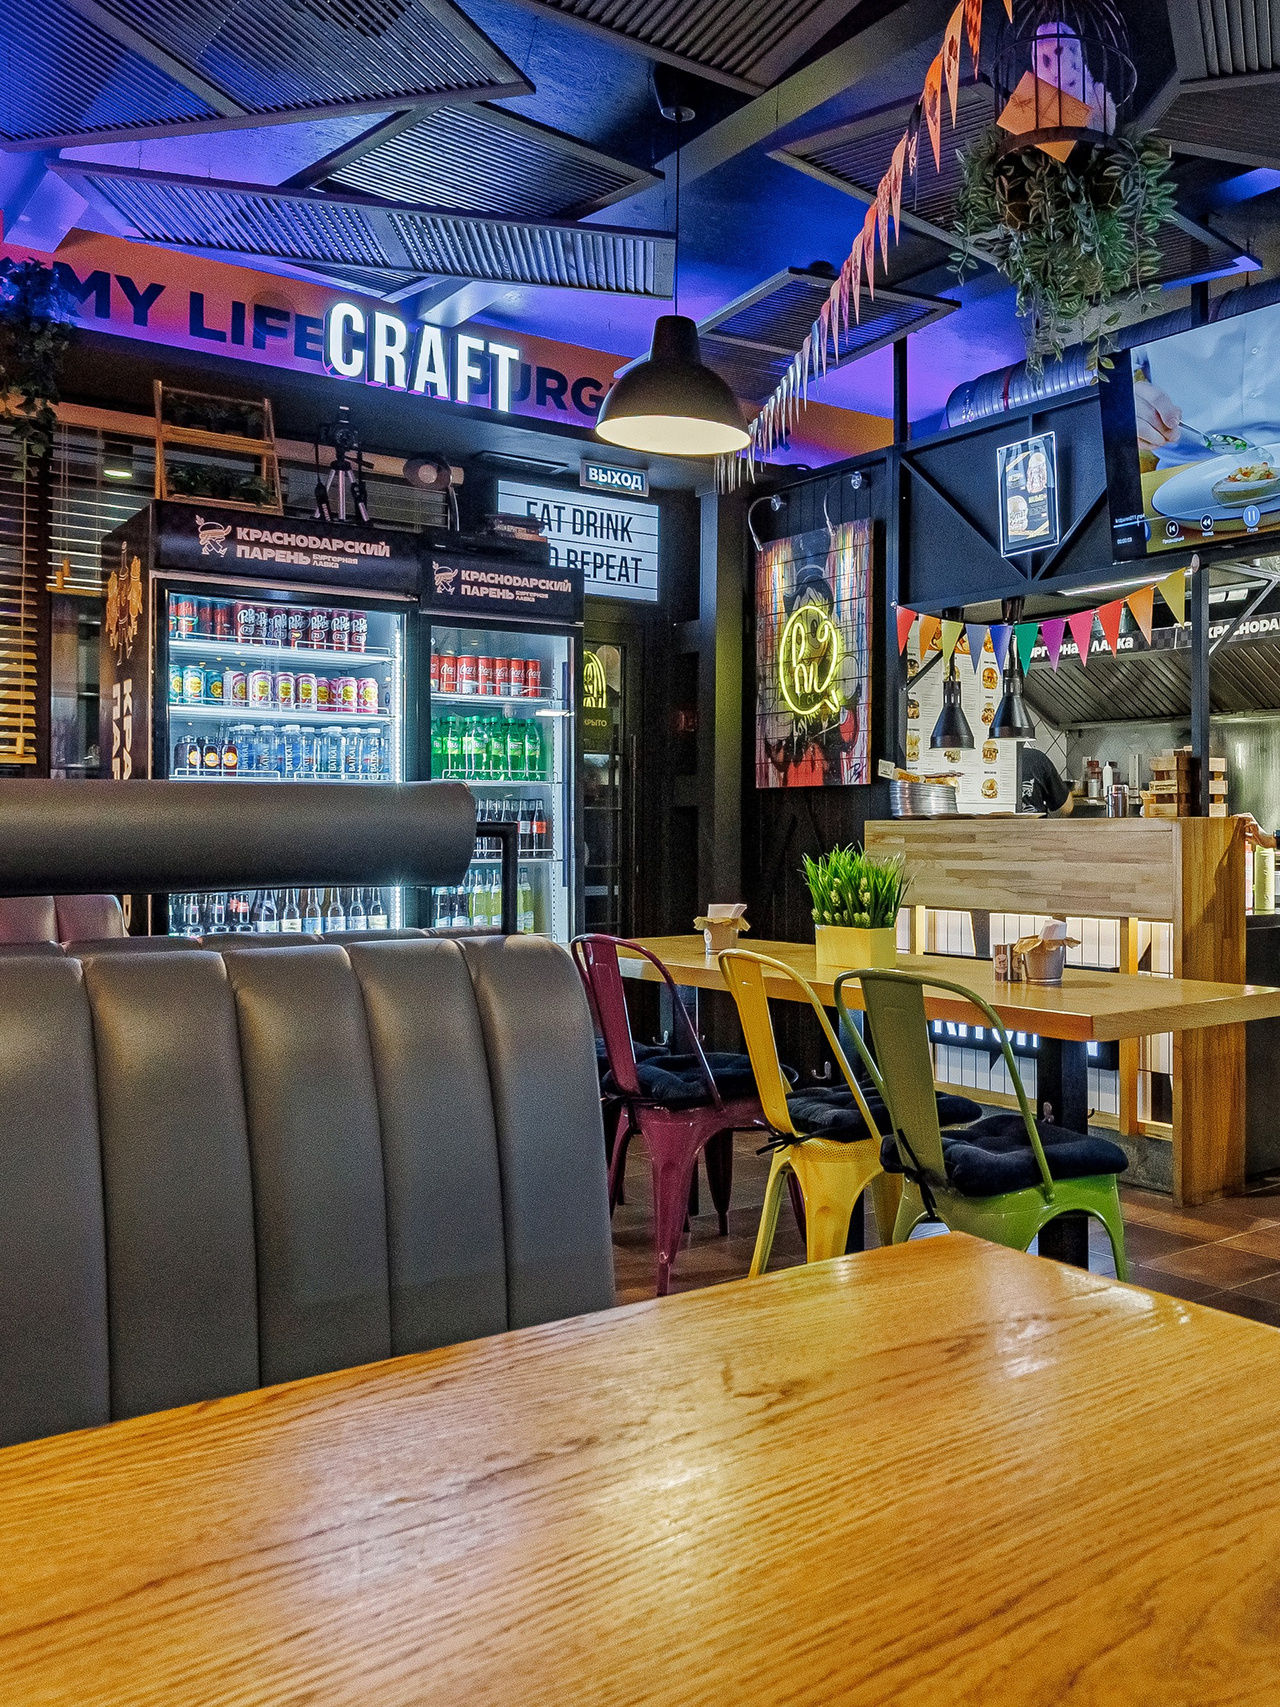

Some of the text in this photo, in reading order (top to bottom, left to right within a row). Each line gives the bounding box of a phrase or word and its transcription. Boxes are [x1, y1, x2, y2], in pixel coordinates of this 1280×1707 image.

[189, 290, 324, 363] LIFE
[327, 302, 520, 413] CRAFT
[588, 466, 643, 491] ВЫХОД
[572, 507, 633, 543] DRINK
[236, 526, 391, 558] КРАСНОДАРСКИЙ
[236, 544, 311, 566] ПАРЕНЬ
[461, 569, 572, 593] КРАСНОДАРСКИЙ
[567, 548, 642, 584] REPEAT
[461, 584, 515, 600] ПАРЕНЬ
